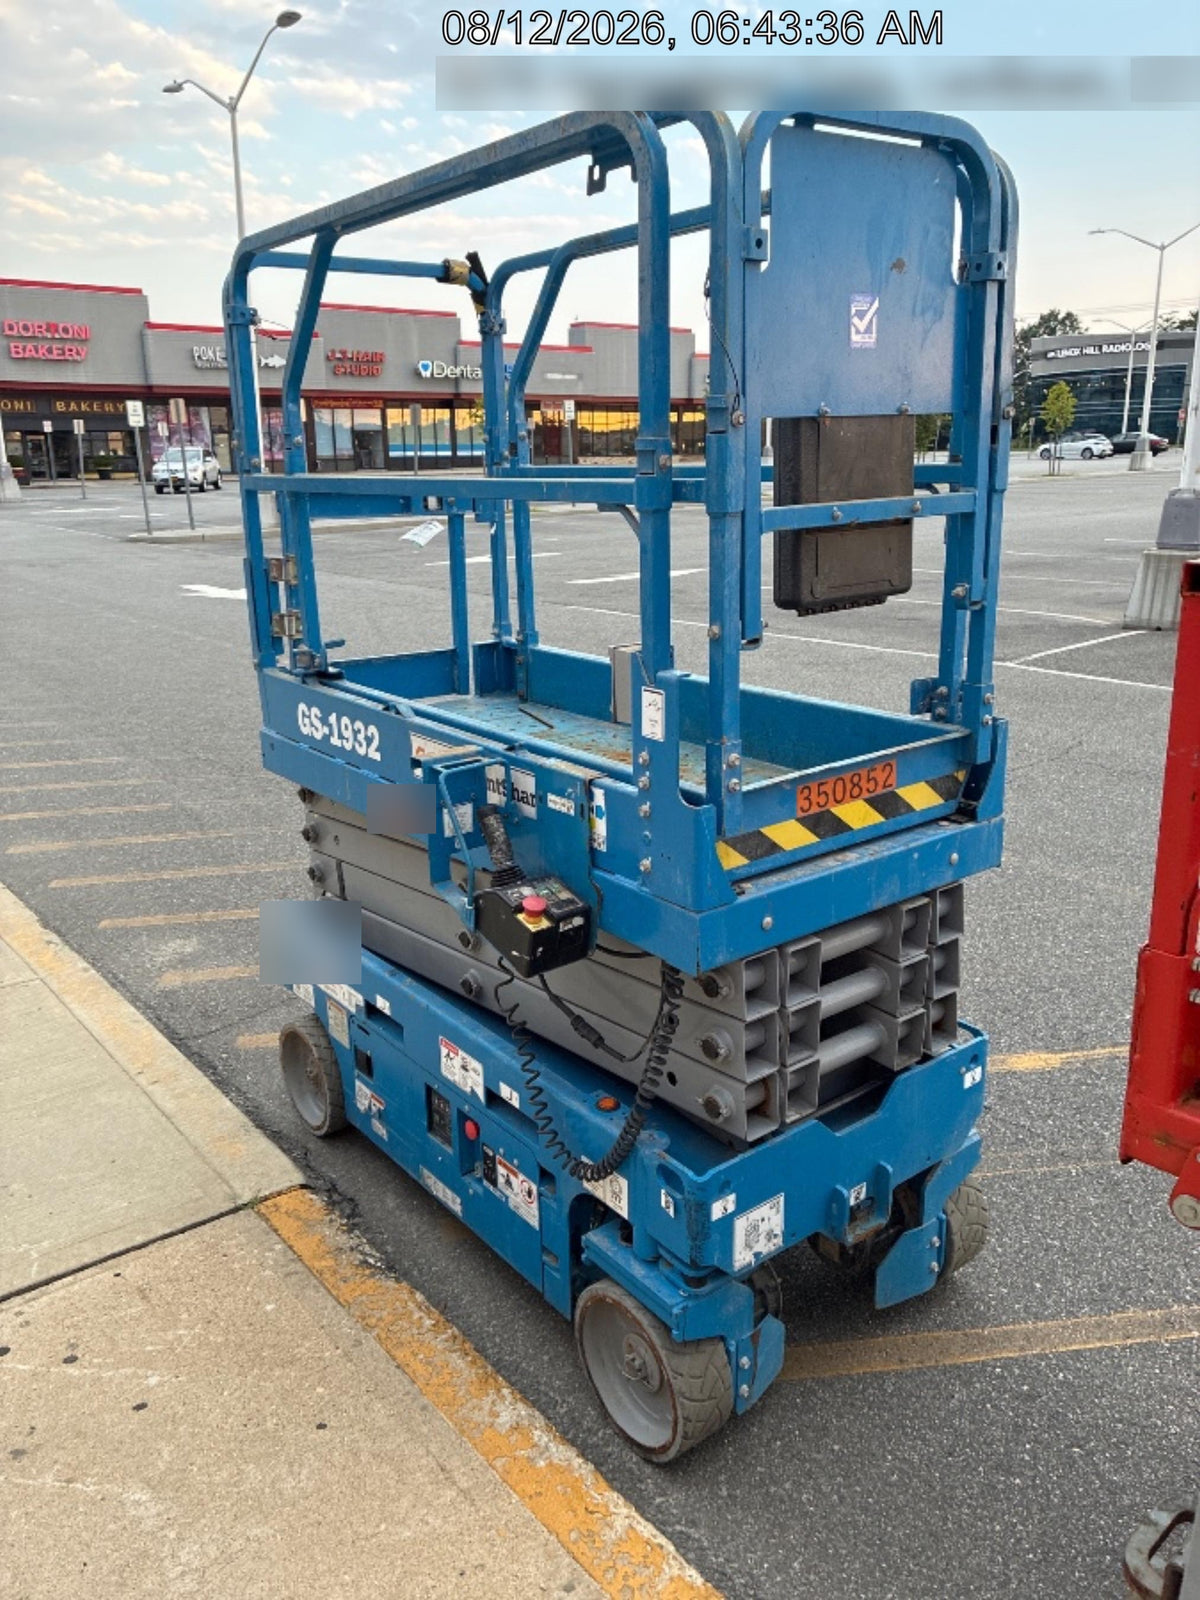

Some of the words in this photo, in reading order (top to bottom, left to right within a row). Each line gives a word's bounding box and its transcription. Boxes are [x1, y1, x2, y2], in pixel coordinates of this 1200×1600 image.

[9, 341, 88, 361] BAKERY
[1083, 345, 1100, 355] HILL
[1102, 340, 1158, 354] RADIOLOG
[352, 350, 386, 363] HAIR
[333, 363, 383, 376] STUDIO
[55, 400, 125, 412] BAKERY
[297, 702, 381, 761] GS-1932
[799, 762, 894, 813] 350852
